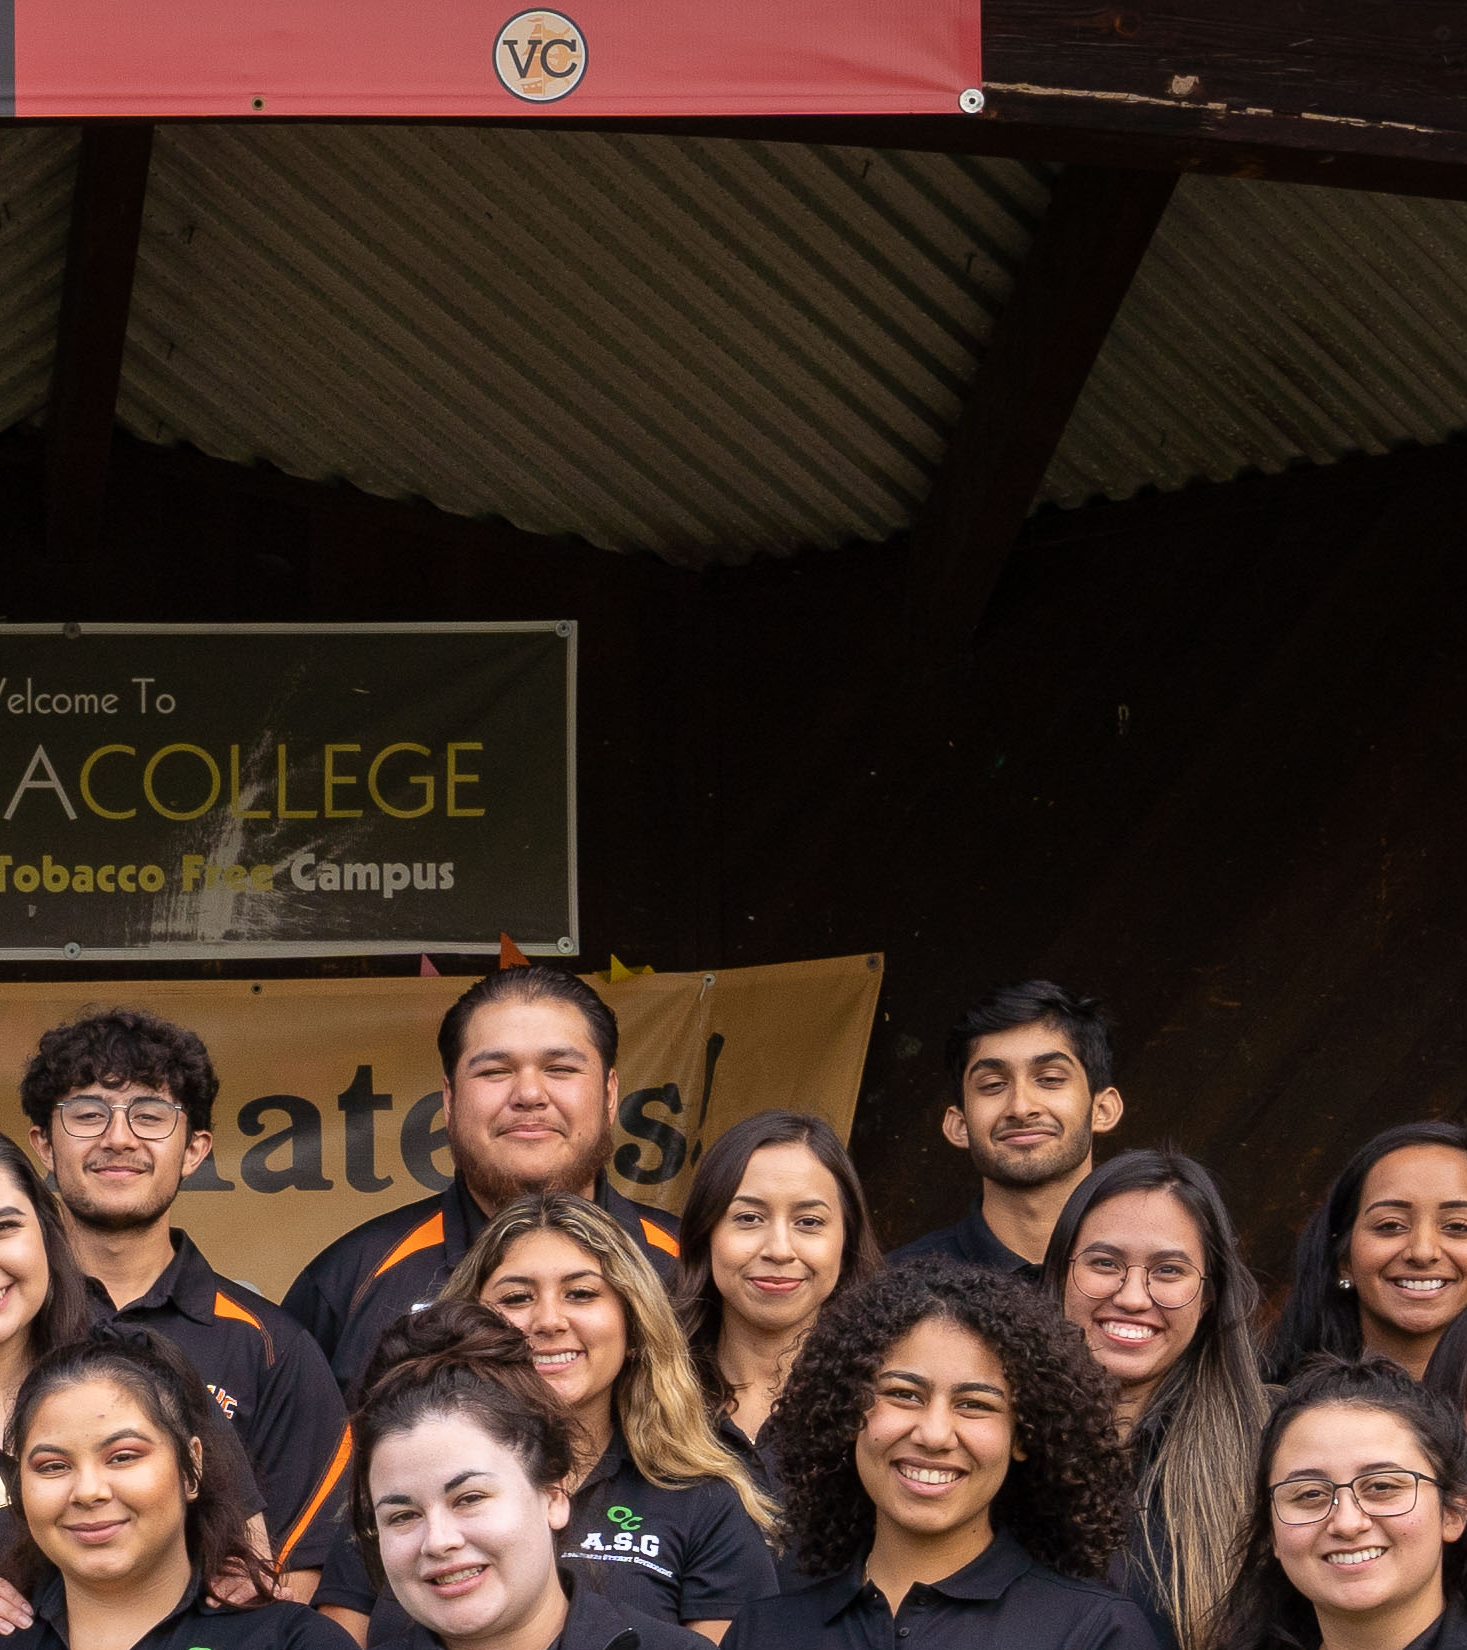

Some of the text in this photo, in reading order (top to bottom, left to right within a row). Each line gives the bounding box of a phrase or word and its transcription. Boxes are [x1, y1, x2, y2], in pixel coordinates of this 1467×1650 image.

[503, 38, 578, 78] VC
[131, 677, 177, 715] To
[181, 853, 275, 893] Free
[289, 852, 456, 899] Campus
